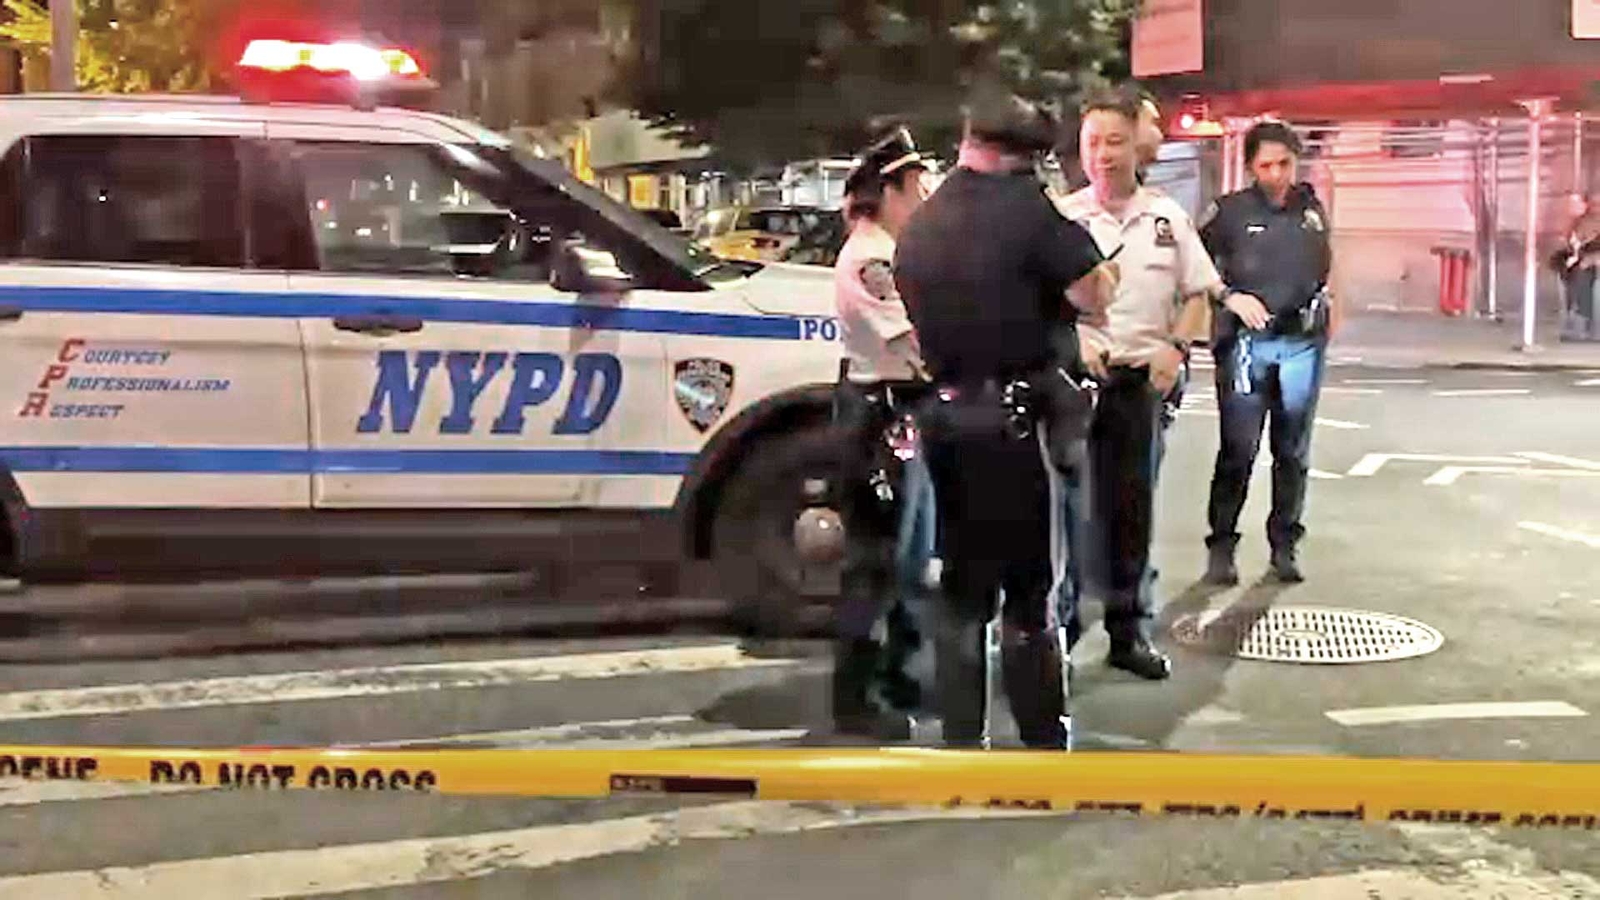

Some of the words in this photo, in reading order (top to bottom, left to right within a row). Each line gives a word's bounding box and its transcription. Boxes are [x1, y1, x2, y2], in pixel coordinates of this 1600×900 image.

[804, 319, 843, 341] PO
[38, 365, 230, 391] PROFESSIONALISM
[19, 392, 125, 417] RESPECT
[357, 350, 623, 435] NYPD
